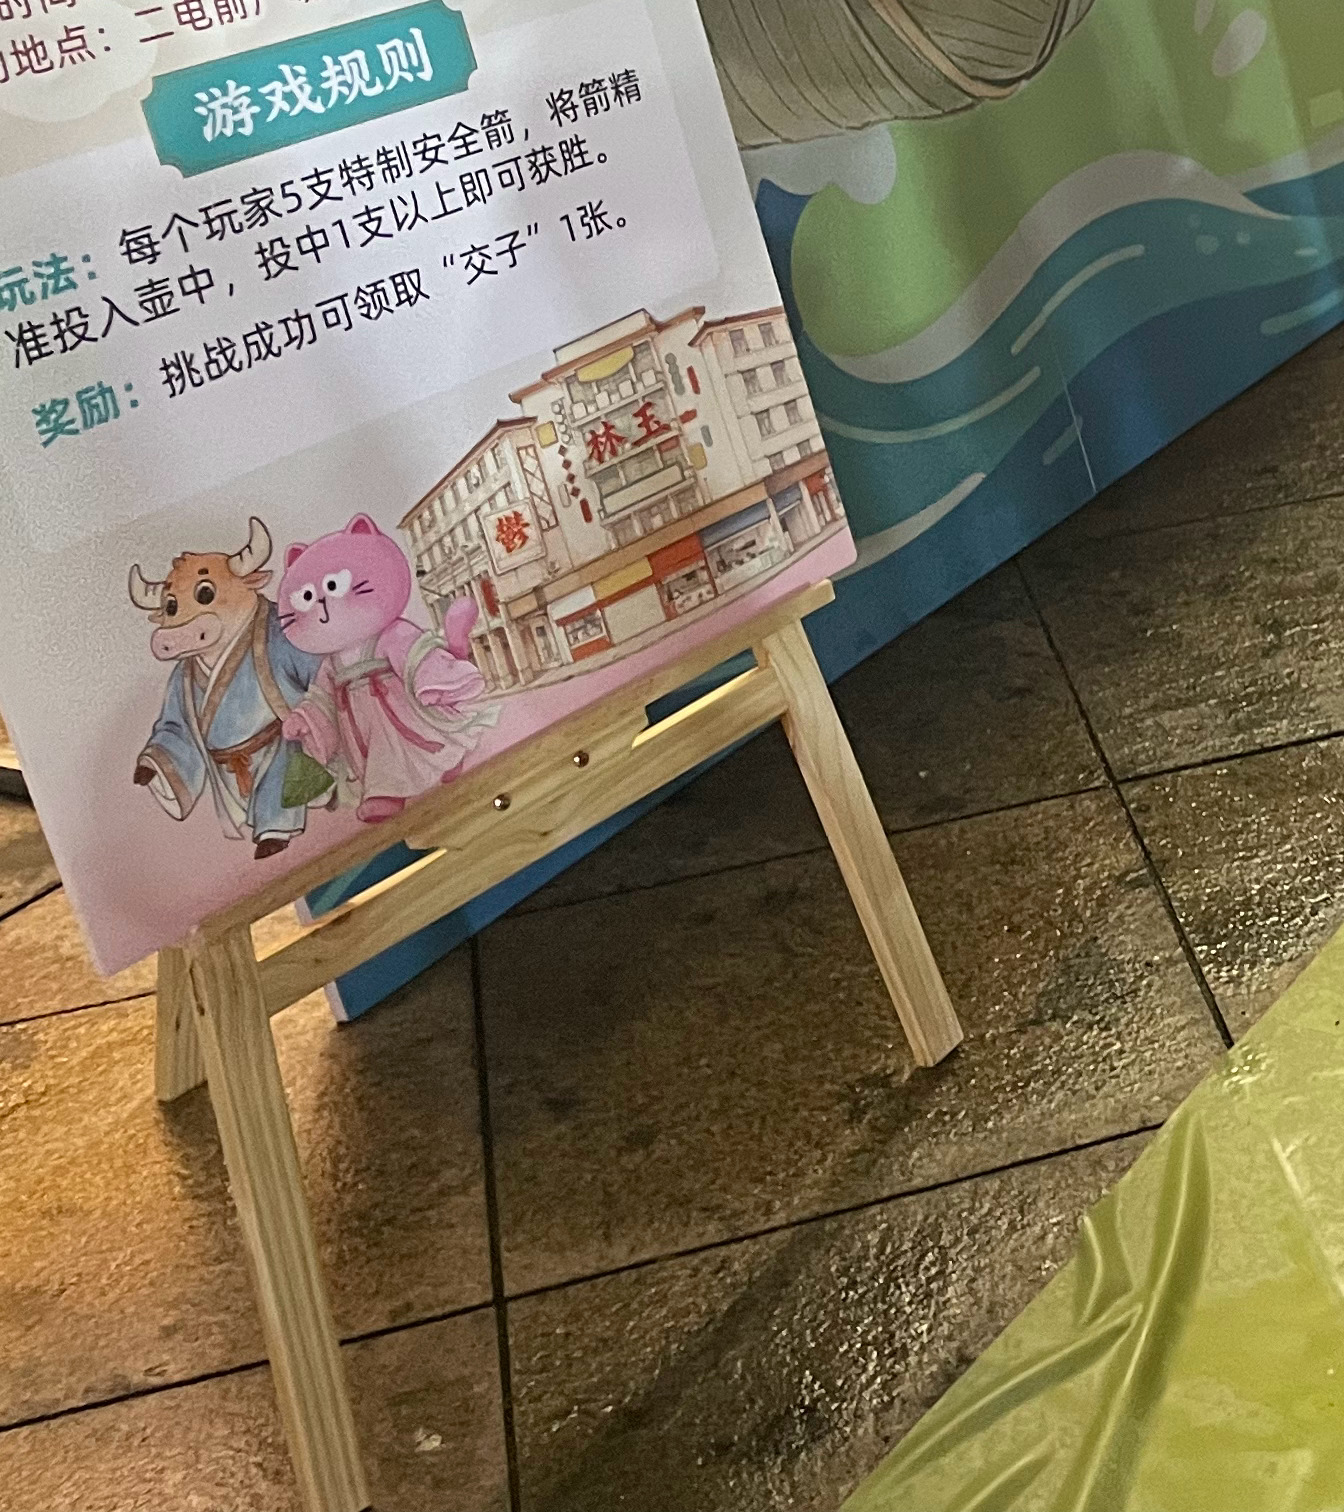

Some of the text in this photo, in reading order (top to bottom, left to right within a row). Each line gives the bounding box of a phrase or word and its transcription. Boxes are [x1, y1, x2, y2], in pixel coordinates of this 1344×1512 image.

[0, 25, 111, 83] 地点：
[194, 27, 433, 144] 游戏规则
[118, 68, 642, 267] 每个玩家5支特制安全箭，将箭精
[5, 135, 611, 369] 准投入壶中，投中1支以上即可获胜。
